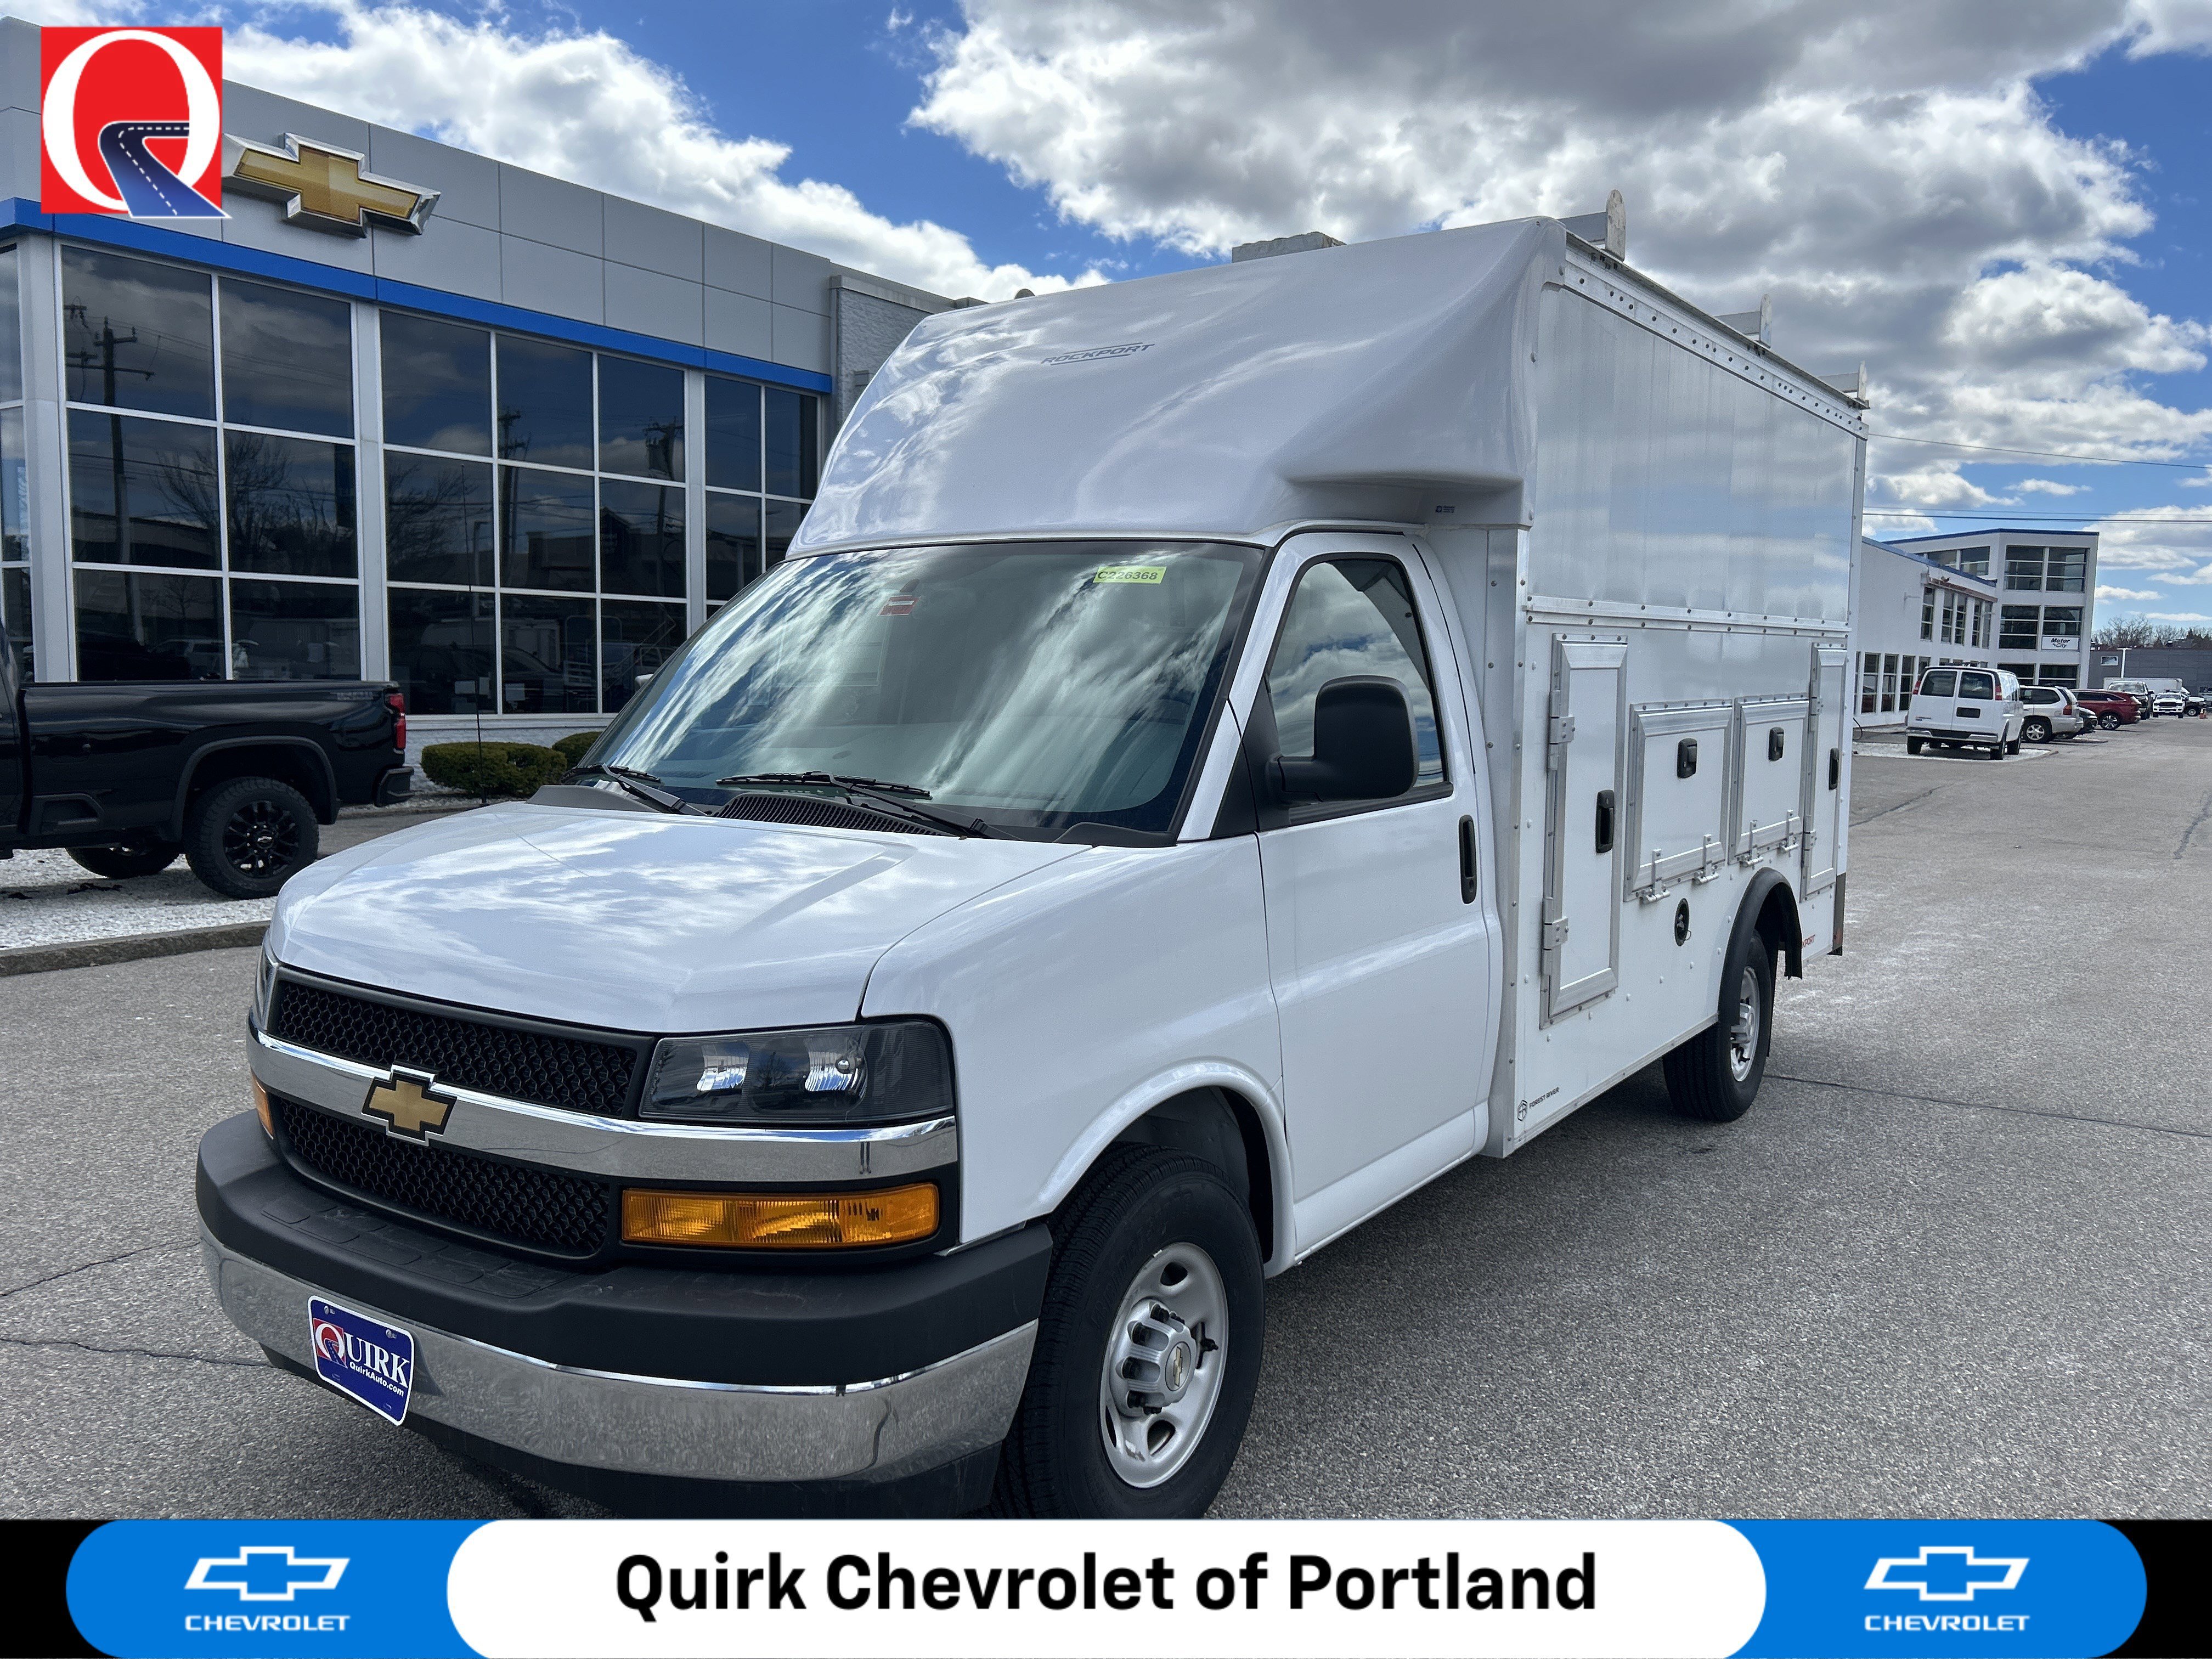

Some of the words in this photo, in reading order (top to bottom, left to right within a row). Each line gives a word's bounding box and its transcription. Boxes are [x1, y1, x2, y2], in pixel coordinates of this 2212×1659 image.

[1041, 343, 1155, 364] ROCKPORT
[1097, 571, 1158, 580] C226368
[315, 1323, 410, 1389] QUIRK
[349, 1361, 404, 1397] QuirkAuto.com
